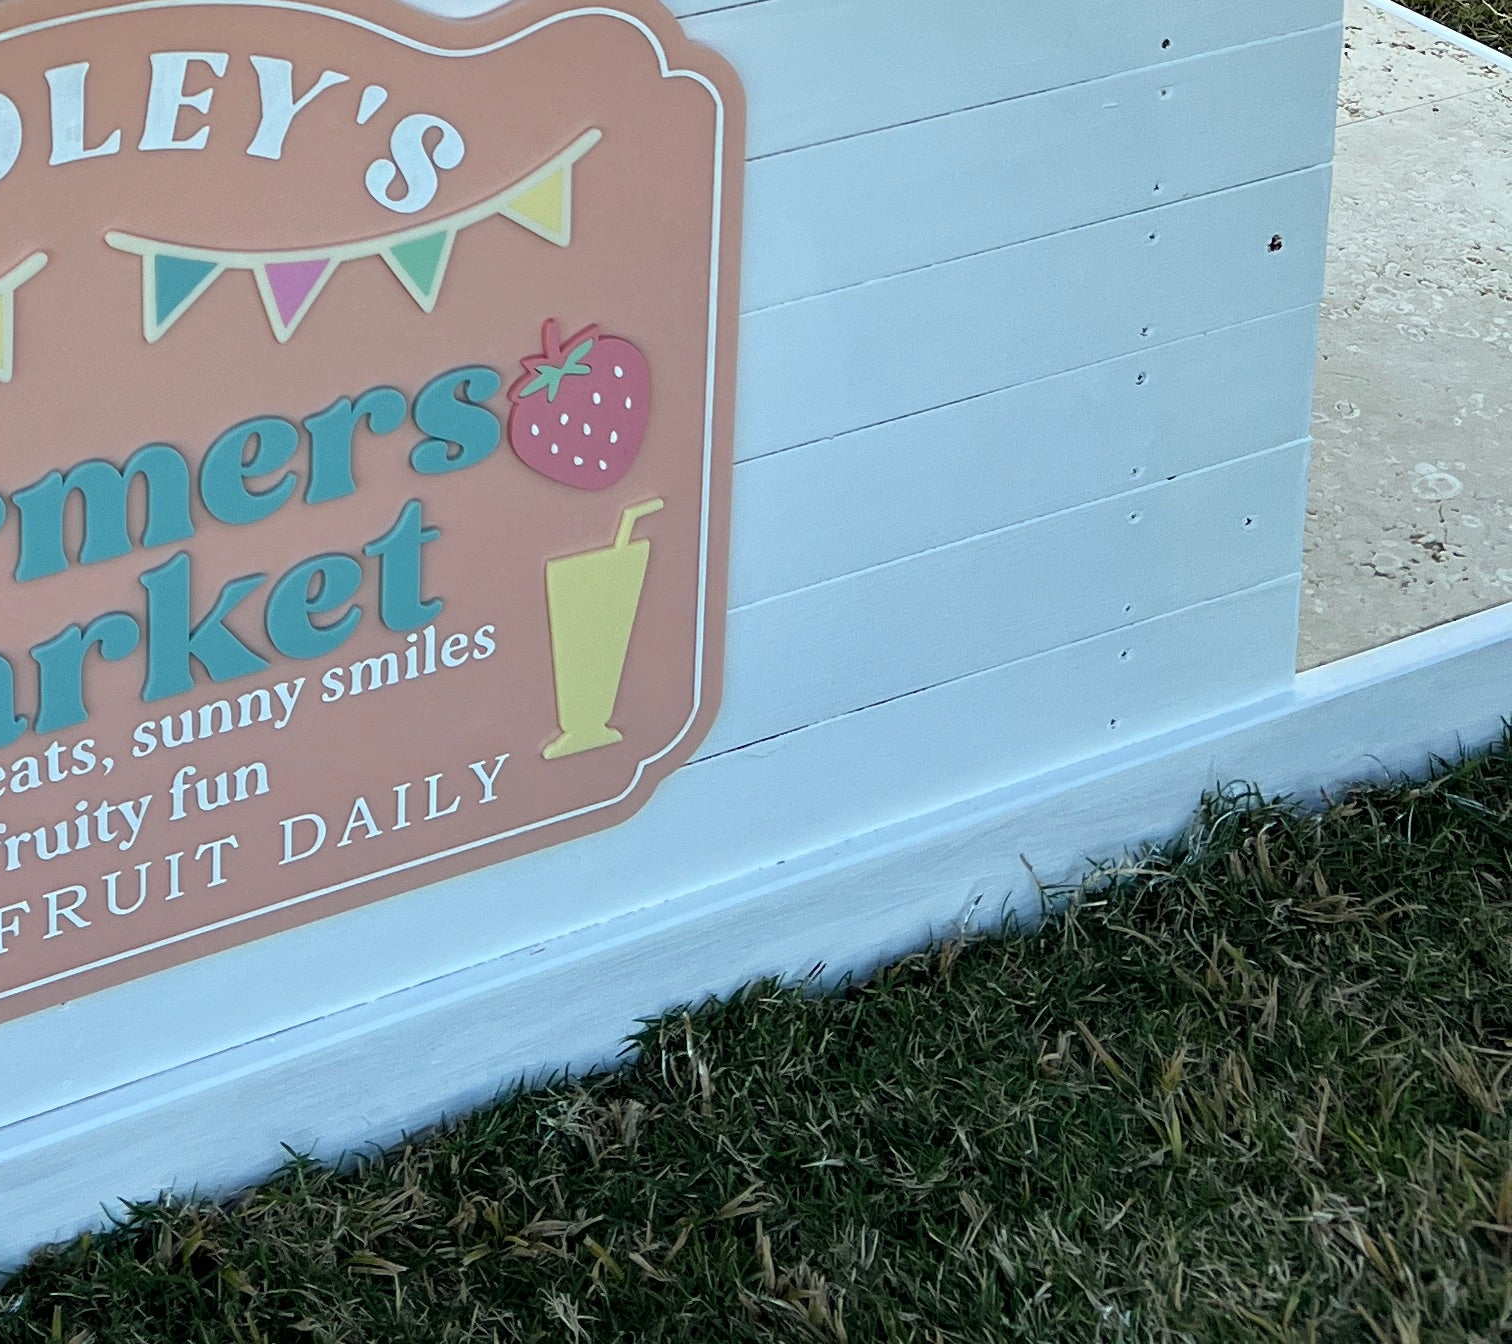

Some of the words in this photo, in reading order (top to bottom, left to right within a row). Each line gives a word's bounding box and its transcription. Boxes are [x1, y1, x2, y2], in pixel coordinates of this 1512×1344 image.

[131, 676, 305, 760] sunny
[320, 624, 496, 703] smiles
[168, 758, 271, 820] fun
[277, 752, 510, 865] DAILY
